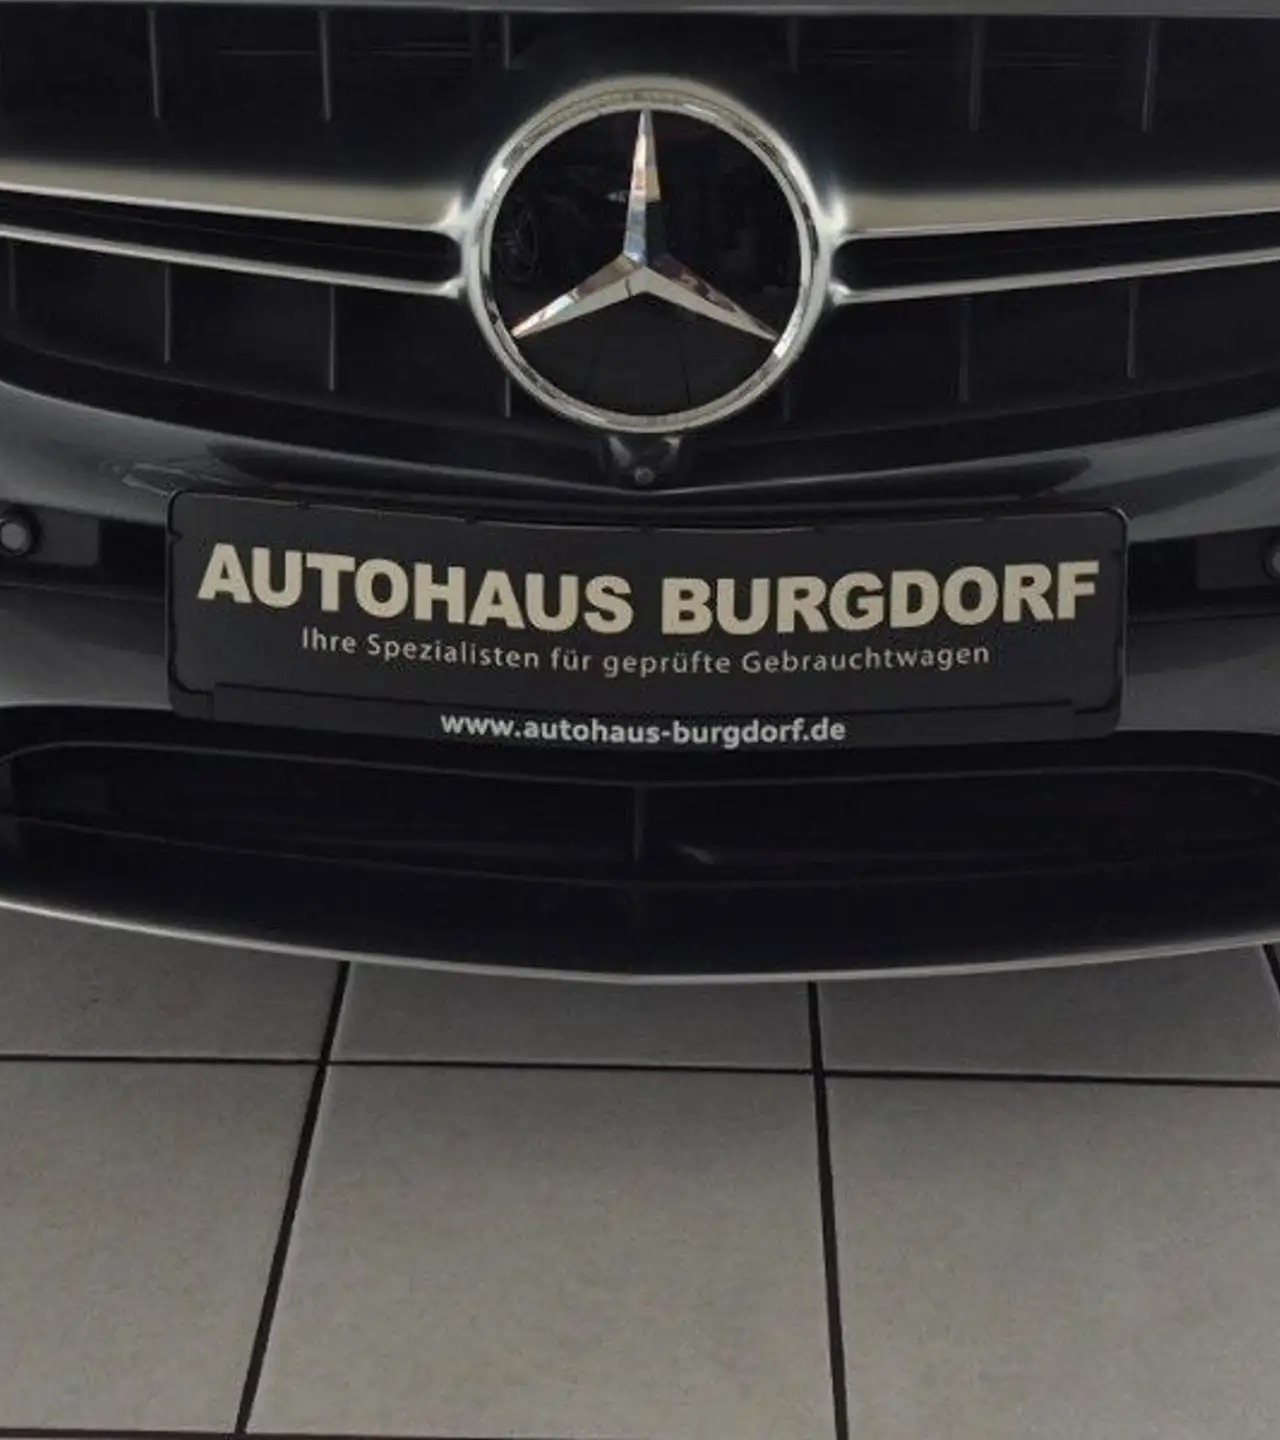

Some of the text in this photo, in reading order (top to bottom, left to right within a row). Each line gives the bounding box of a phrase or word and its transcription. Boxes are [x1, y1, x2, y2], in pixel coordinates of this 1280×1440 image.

[197, 542, 1100, 636] AUTOHAUS BURGDORF
[302, 626, 990, 678] Ihre Spezialisten für geprüfte Gebrauchtwagen
[440, 715, 846, 750] www.autohaus-burgdorf.de
